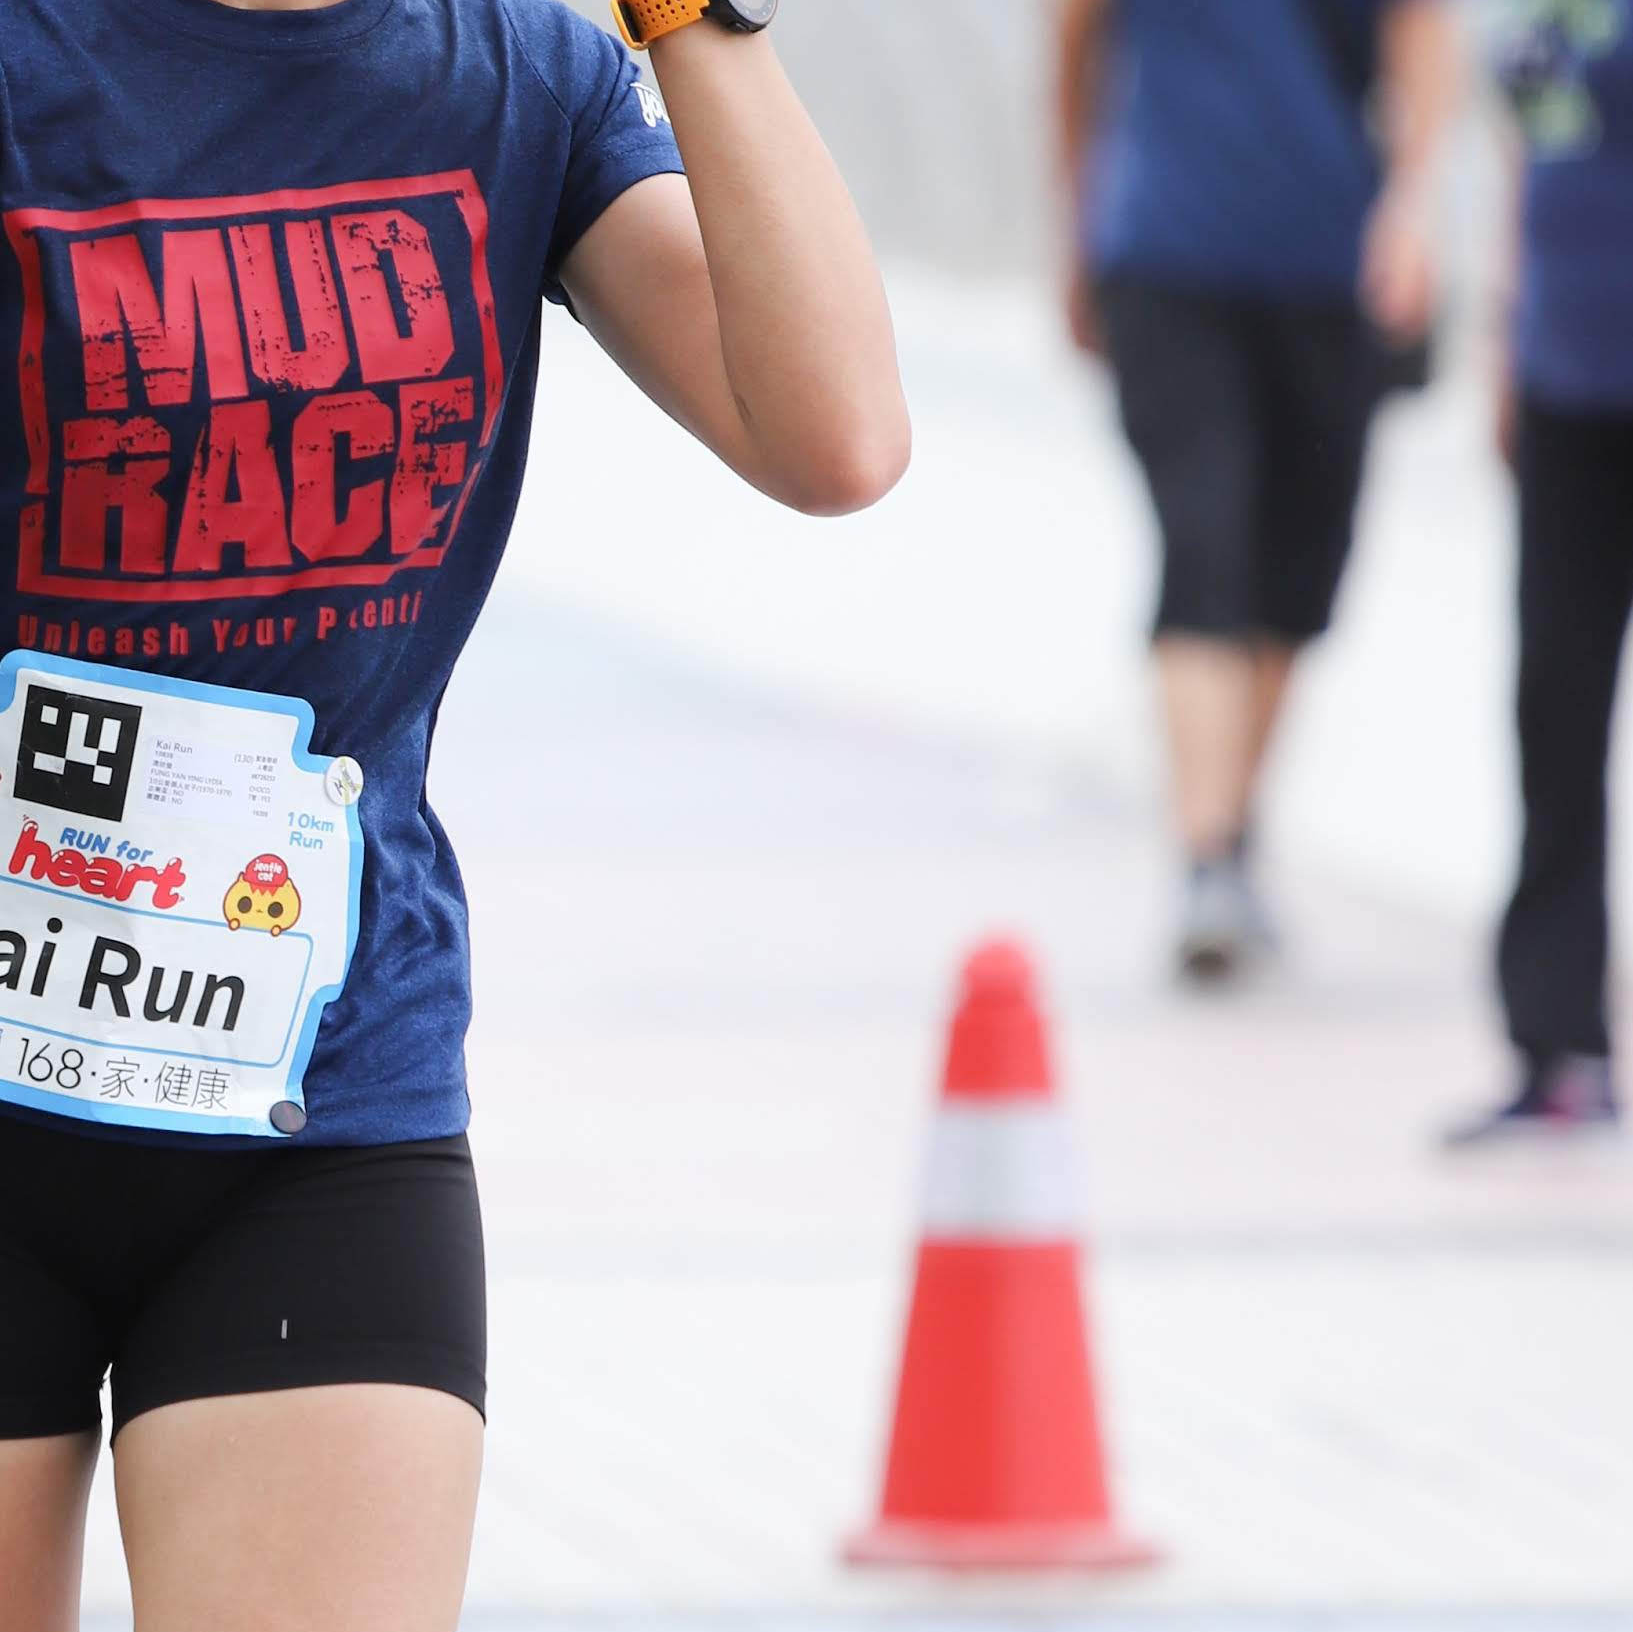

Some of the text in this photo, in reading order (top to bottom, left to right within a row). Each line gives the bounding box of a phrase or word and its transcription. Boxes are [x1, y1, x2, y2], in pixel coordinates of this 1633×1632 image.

[70, 210, 456, 411] MUD
[60, 376, 474, 575] RACE
[17, 614, 189, 656] Unleash
[156, 739, 193, 754] Kai Run
[288, 811, 335, 833] 10km
[289, 830, 324, 850] Run
[8, 820, 187, 910] heart
[59, 826, 153, 862] RUN for
[78, 935, 246, 1032] Run
